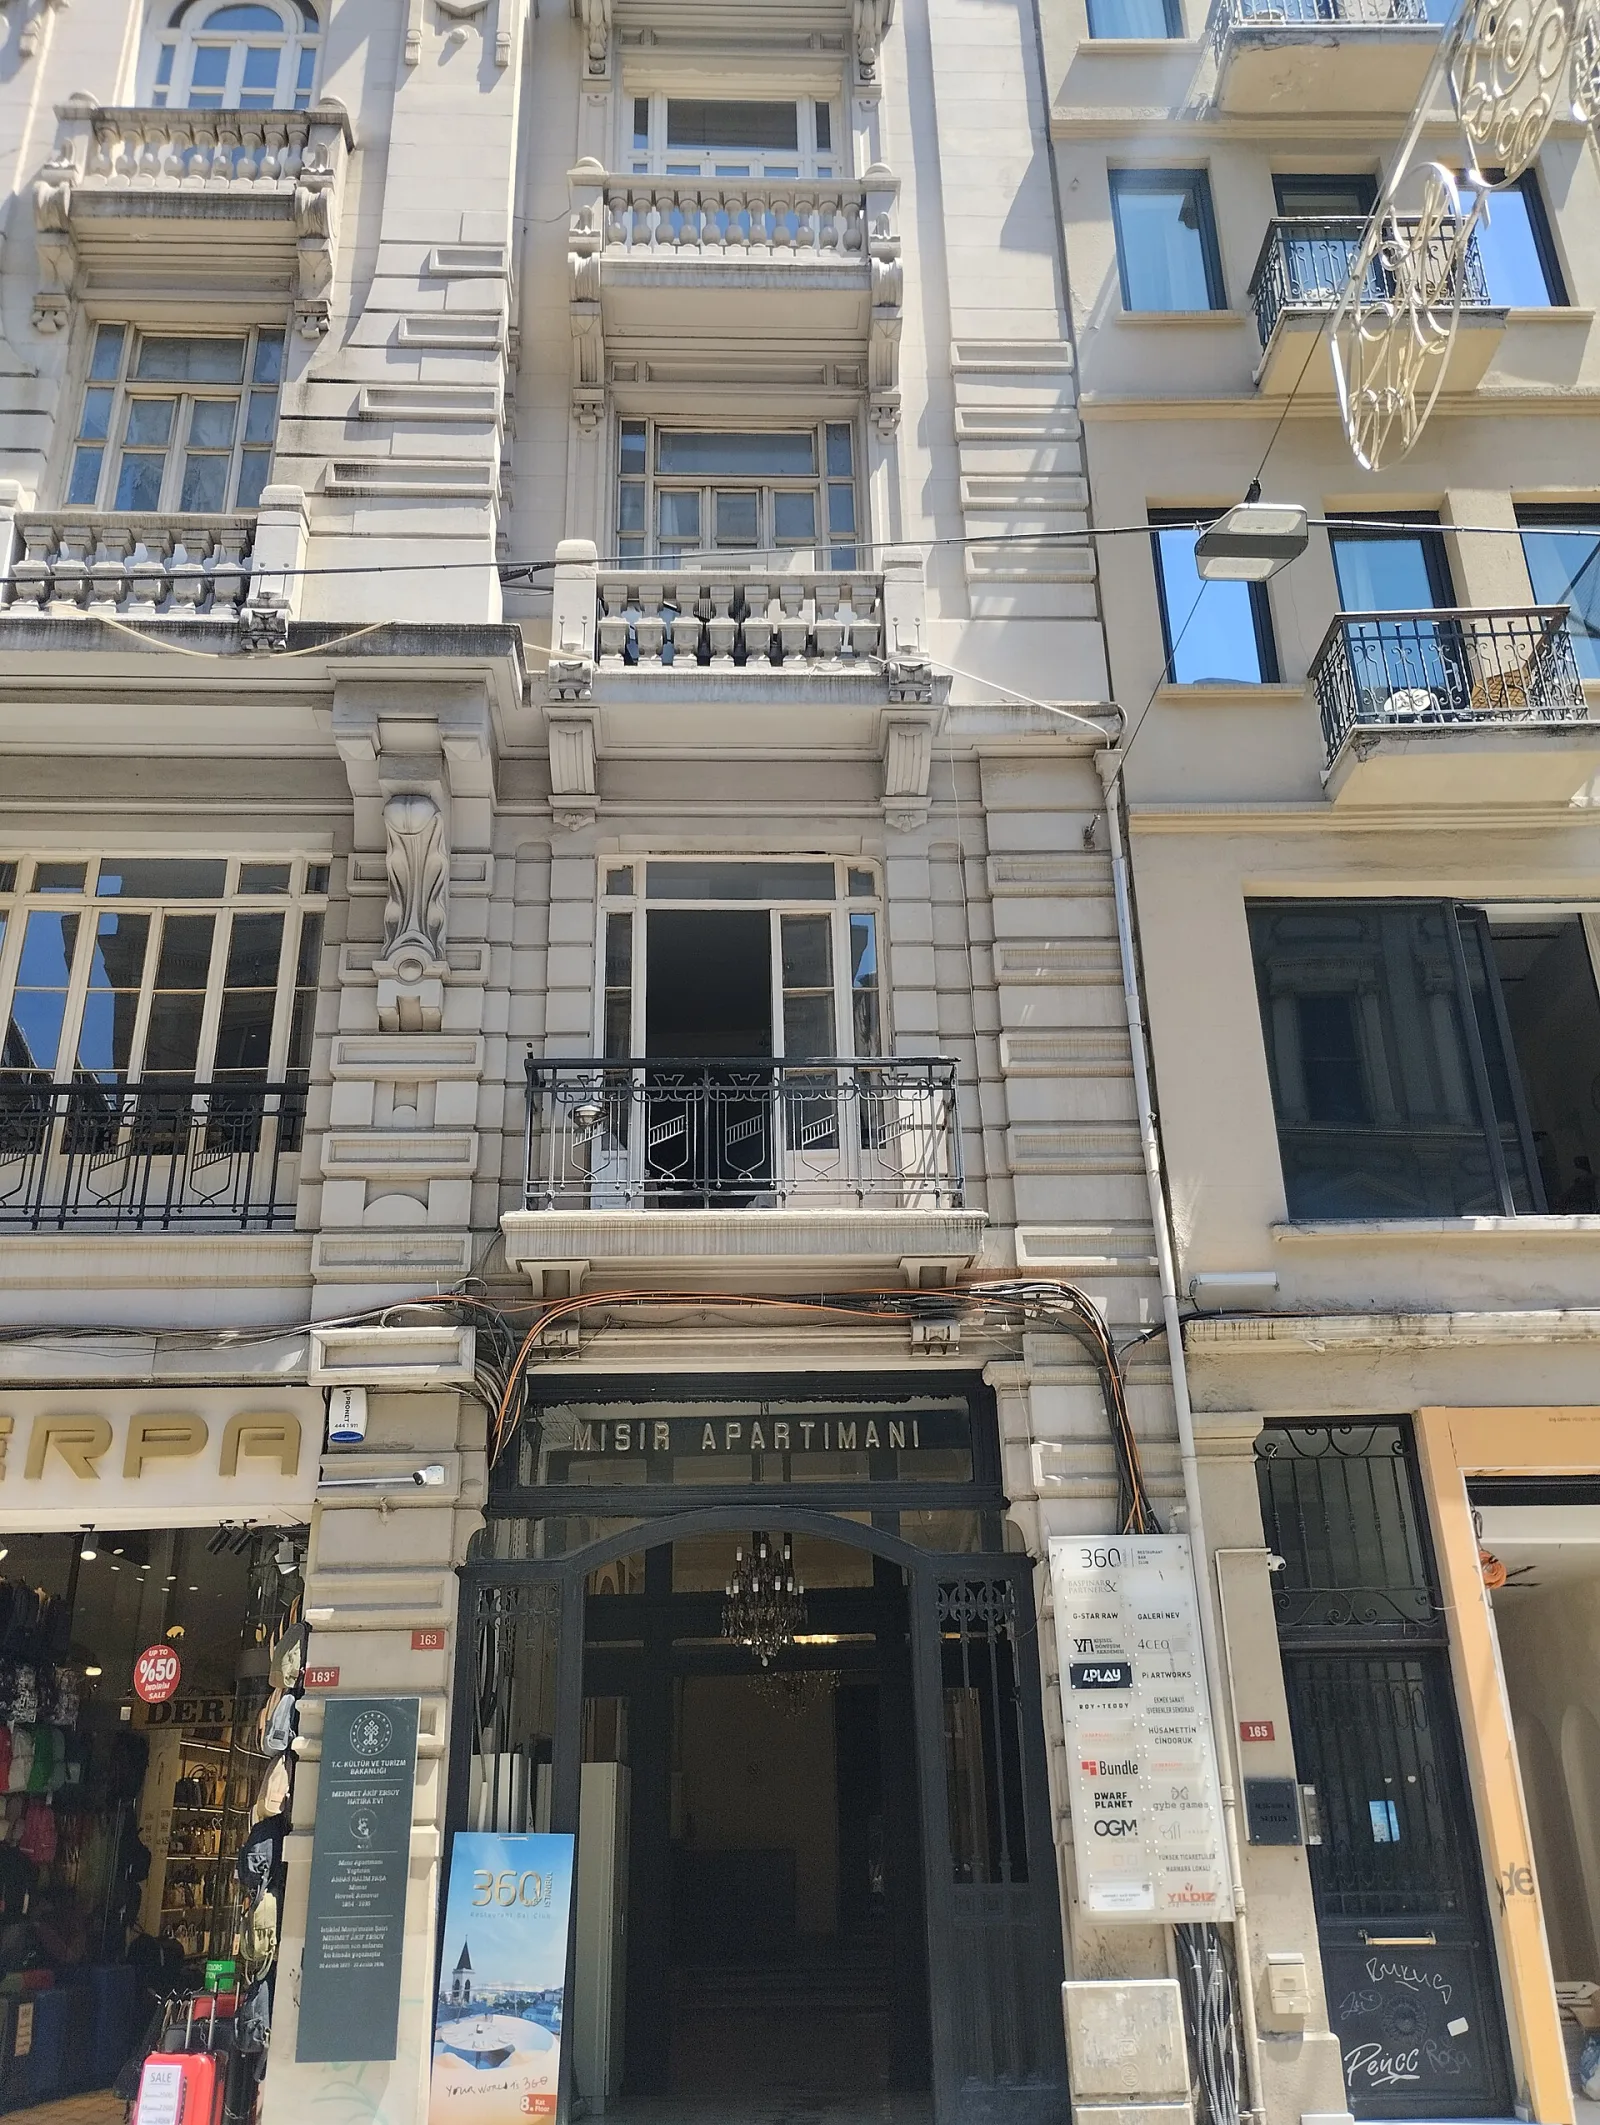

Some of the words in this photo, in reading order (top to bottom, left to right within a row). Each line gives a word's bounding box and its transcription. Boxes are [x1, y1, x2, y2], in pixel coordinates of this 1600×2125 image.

[573, 1422, 670, 1452] MISIR
[702, 1420, 920, 1450] APARTIMANI
[0, 1412, 302, 1480] RPA
[1080, 1548, 1121, 1568] 360
[1137, 1611, 1164, 1620] GALERİ
[419, 1634, 437, 1646] 163
[139, 1657, 177, 1683] %50
[148, 1691, 166, 1699] SALE
[1148, 1726, 1197, 1734] HÜSAMETTİN
[1249, 1725, 1268, 1738] 165
[344, 1760, 370, 1768] KÜLTÜR
[1099, 1760, 1139, 1776] Bundle
[350, 1767, 387, 1775] BAKANLIĞI
[1094, 1791, 1127, 1800] DWARF
[1095, 1800, 1133, 1809] PLANET
[1153, 1801, 1177, 1811] gybe
[1179, 1801, 1209, 1811] games
[472, 1869, 542, 1907] 360
[150, 2072, 172, 2083] SALE
